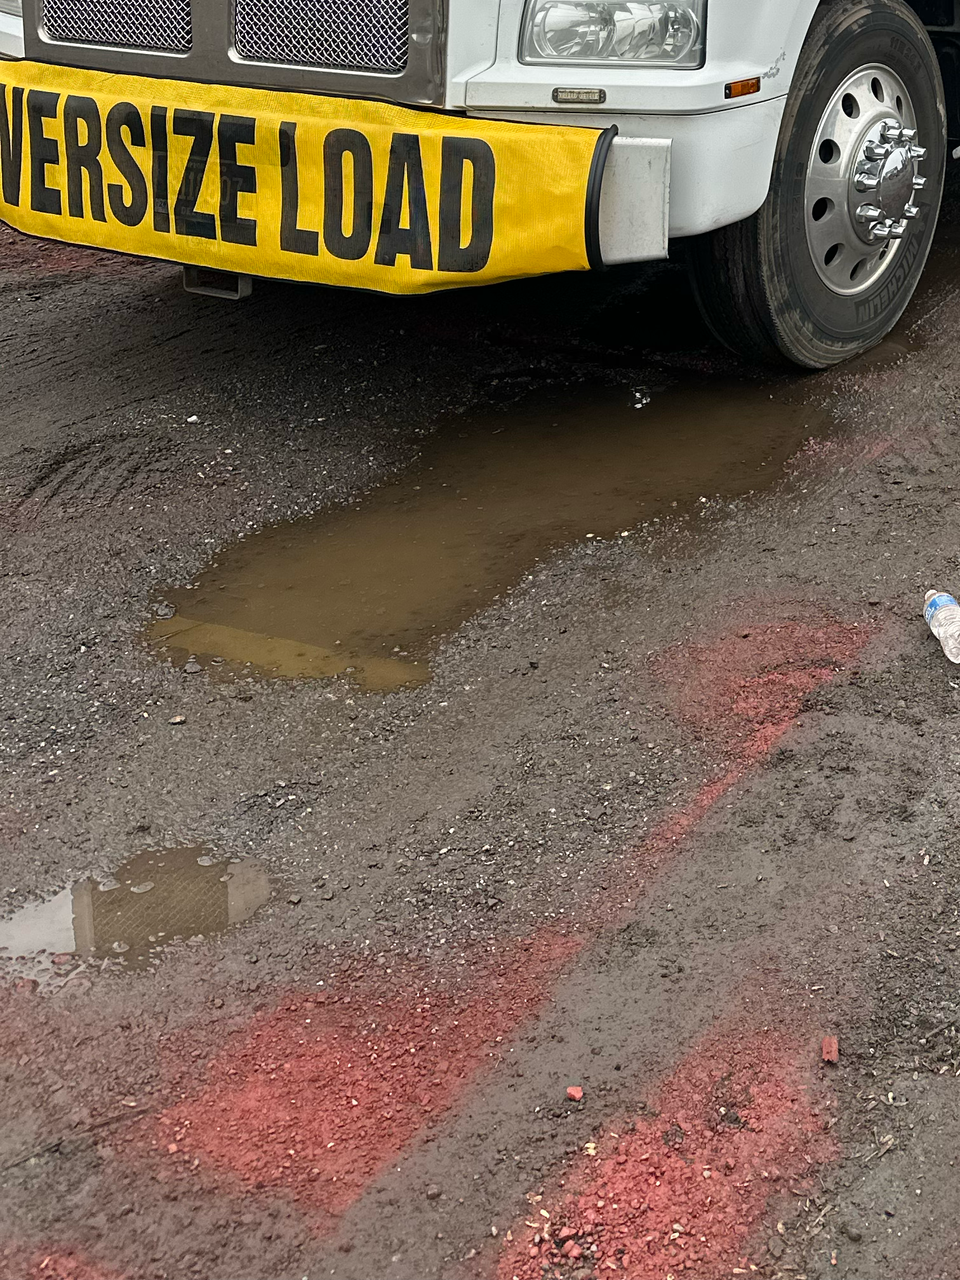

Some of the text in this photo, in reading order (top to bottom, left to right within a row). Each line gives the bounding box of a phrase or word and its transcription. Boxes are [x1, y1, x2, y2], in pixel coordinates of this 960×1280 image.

[0, 83, 496, 273] VERSIZE LOAD
[857, 236, 920, 324] MICHELIN
